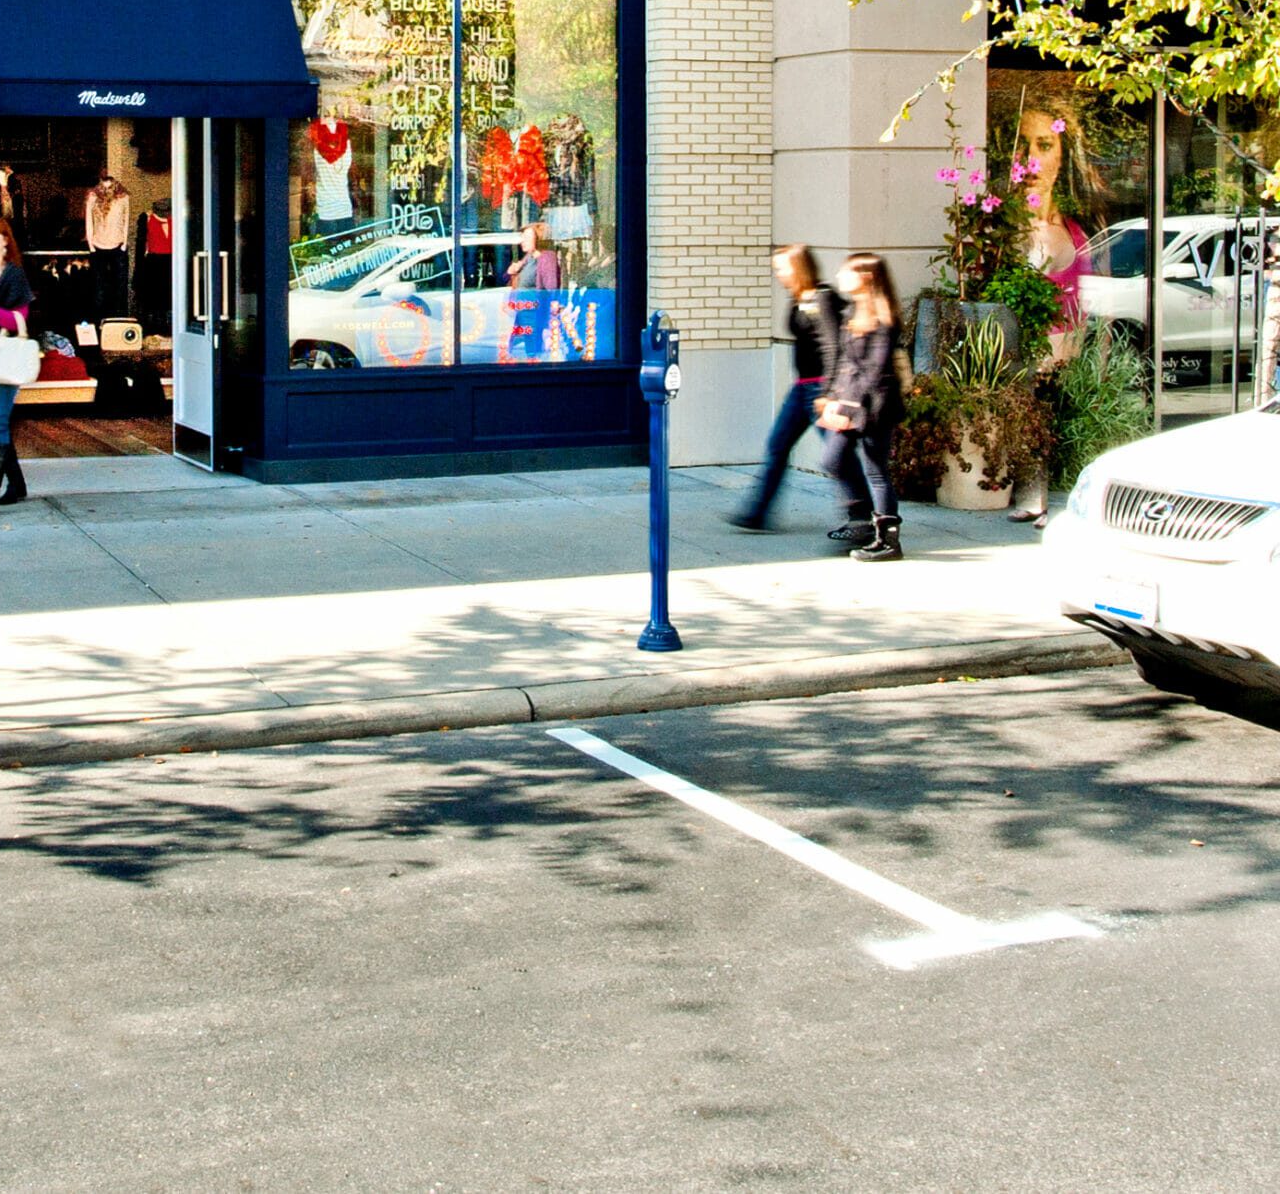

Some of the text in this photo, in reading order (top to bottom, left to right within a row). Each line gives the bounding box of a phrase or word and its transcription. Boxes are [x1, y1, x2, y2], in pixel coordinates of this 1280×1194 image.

[470, 25, 510, 43] HILL
[468, 55, 510, 83] ROAD
[77, 90, 147, 108] Madewell
[376, 299, 597, 367] OPEN
[1180, 355, 1203, 371] Sexy
